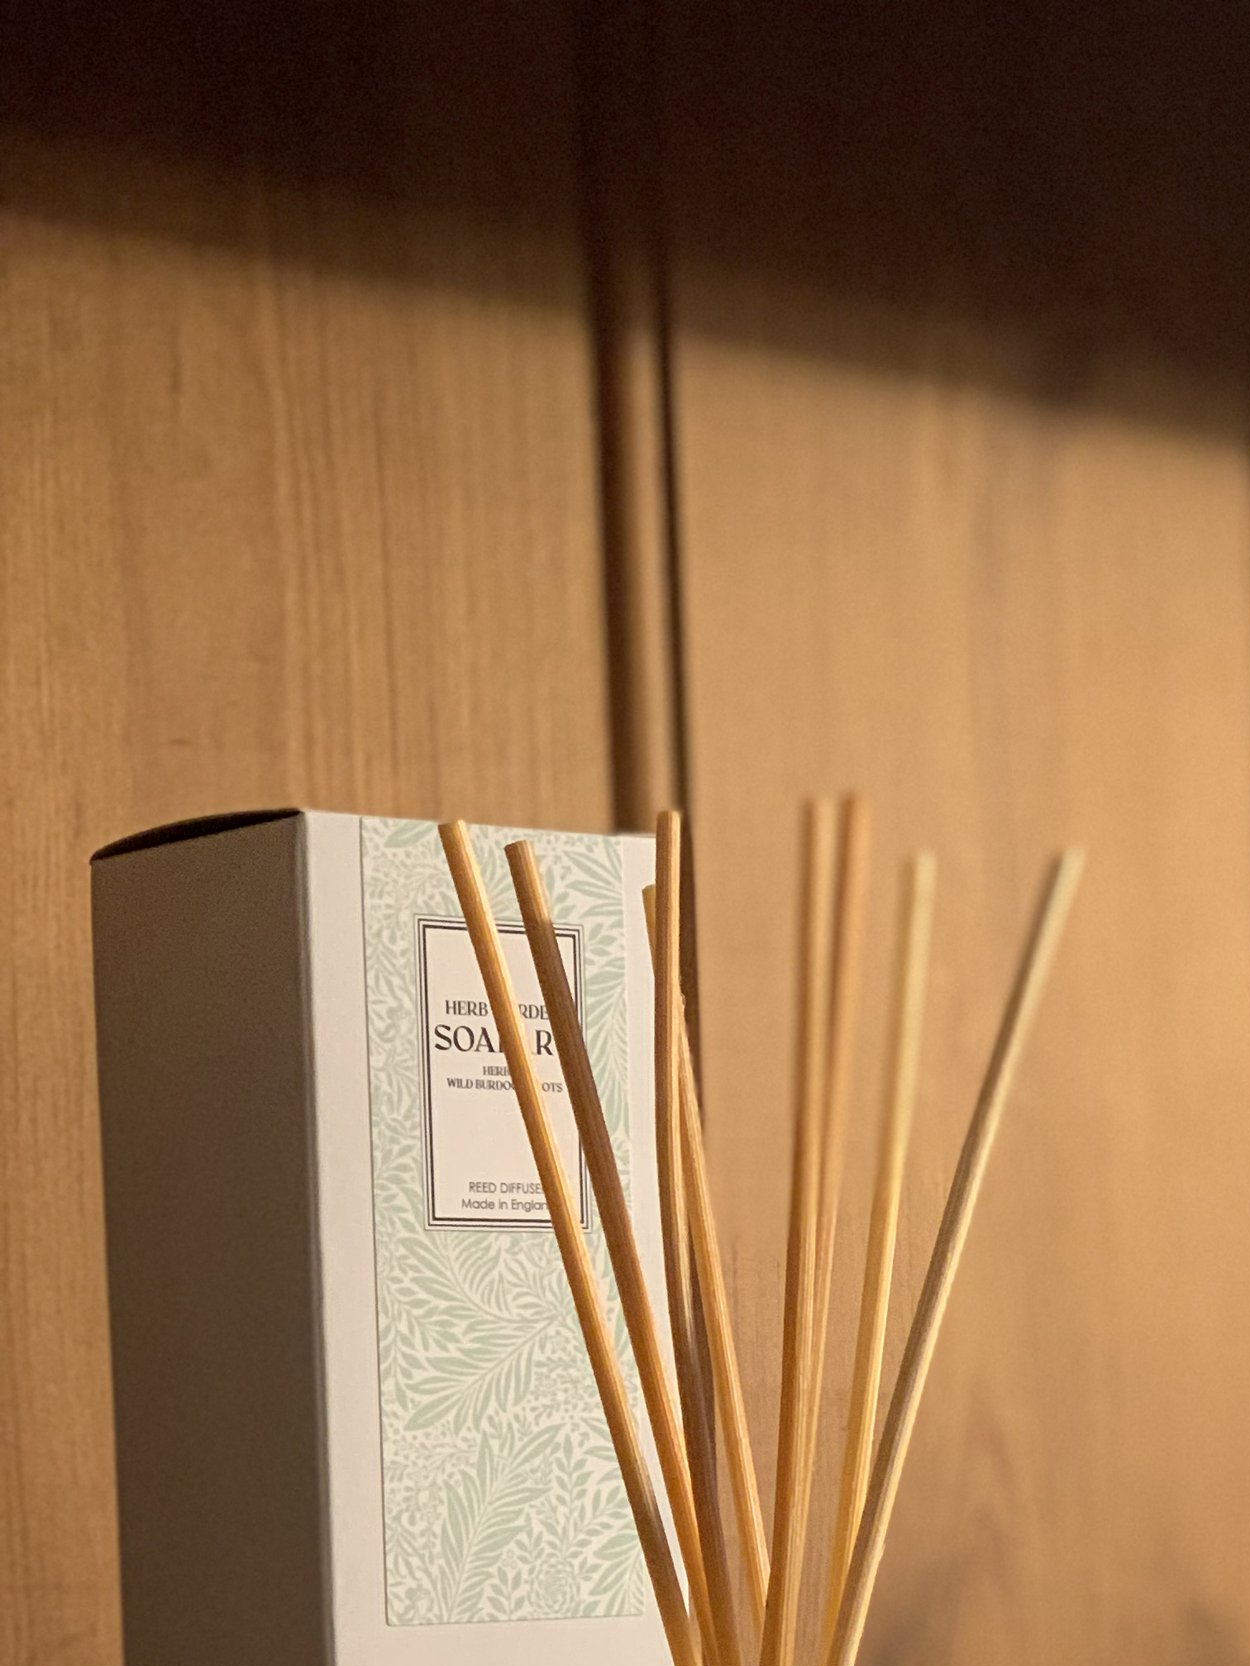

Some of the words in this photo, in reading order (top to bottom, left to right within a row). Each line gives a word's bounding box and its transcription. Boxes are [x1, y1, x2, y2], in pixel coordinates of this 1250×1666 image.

[446, 1000, 488, 1017] HERB
[434, 1024, 554, 1055] SOAR
[446, 1077, 474, 1089] WILD
[468, 1181, 497, 1194] REED
[461, 1198, 495, 1210] Made
[498, 1199, 508, 1210] in
[511, 1199, 549, 1212] Englan
